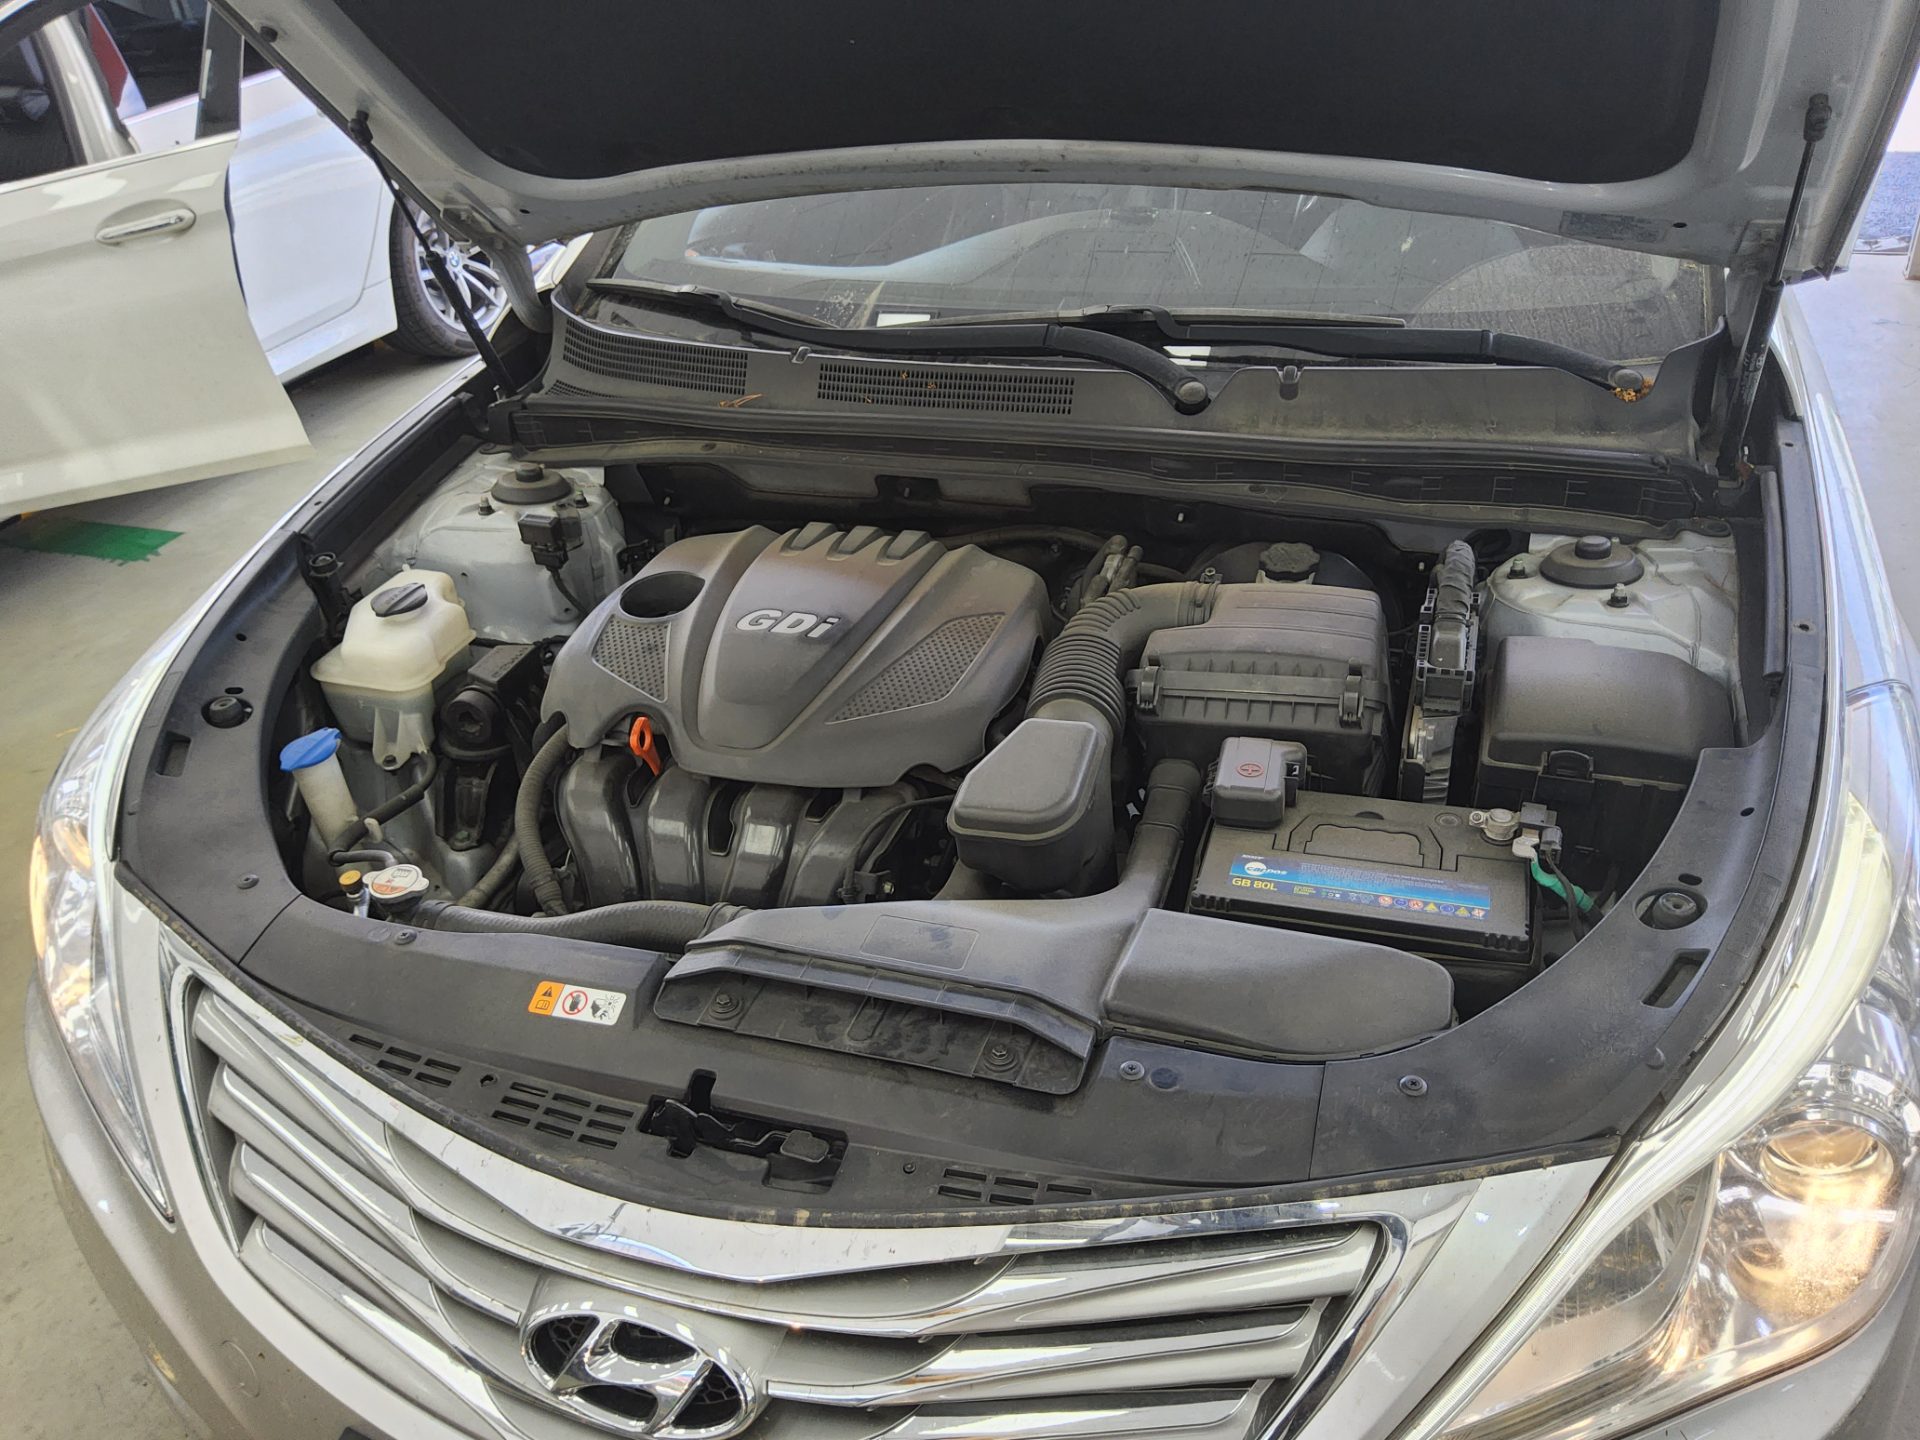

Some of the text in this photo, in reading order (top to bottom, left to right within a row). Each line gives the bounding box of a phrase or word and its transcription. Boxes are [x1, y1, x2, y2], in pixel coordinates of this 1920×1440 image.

[736, 609, 841, 638] GDi
[1232, 878, 1278, 891] GB 80L
